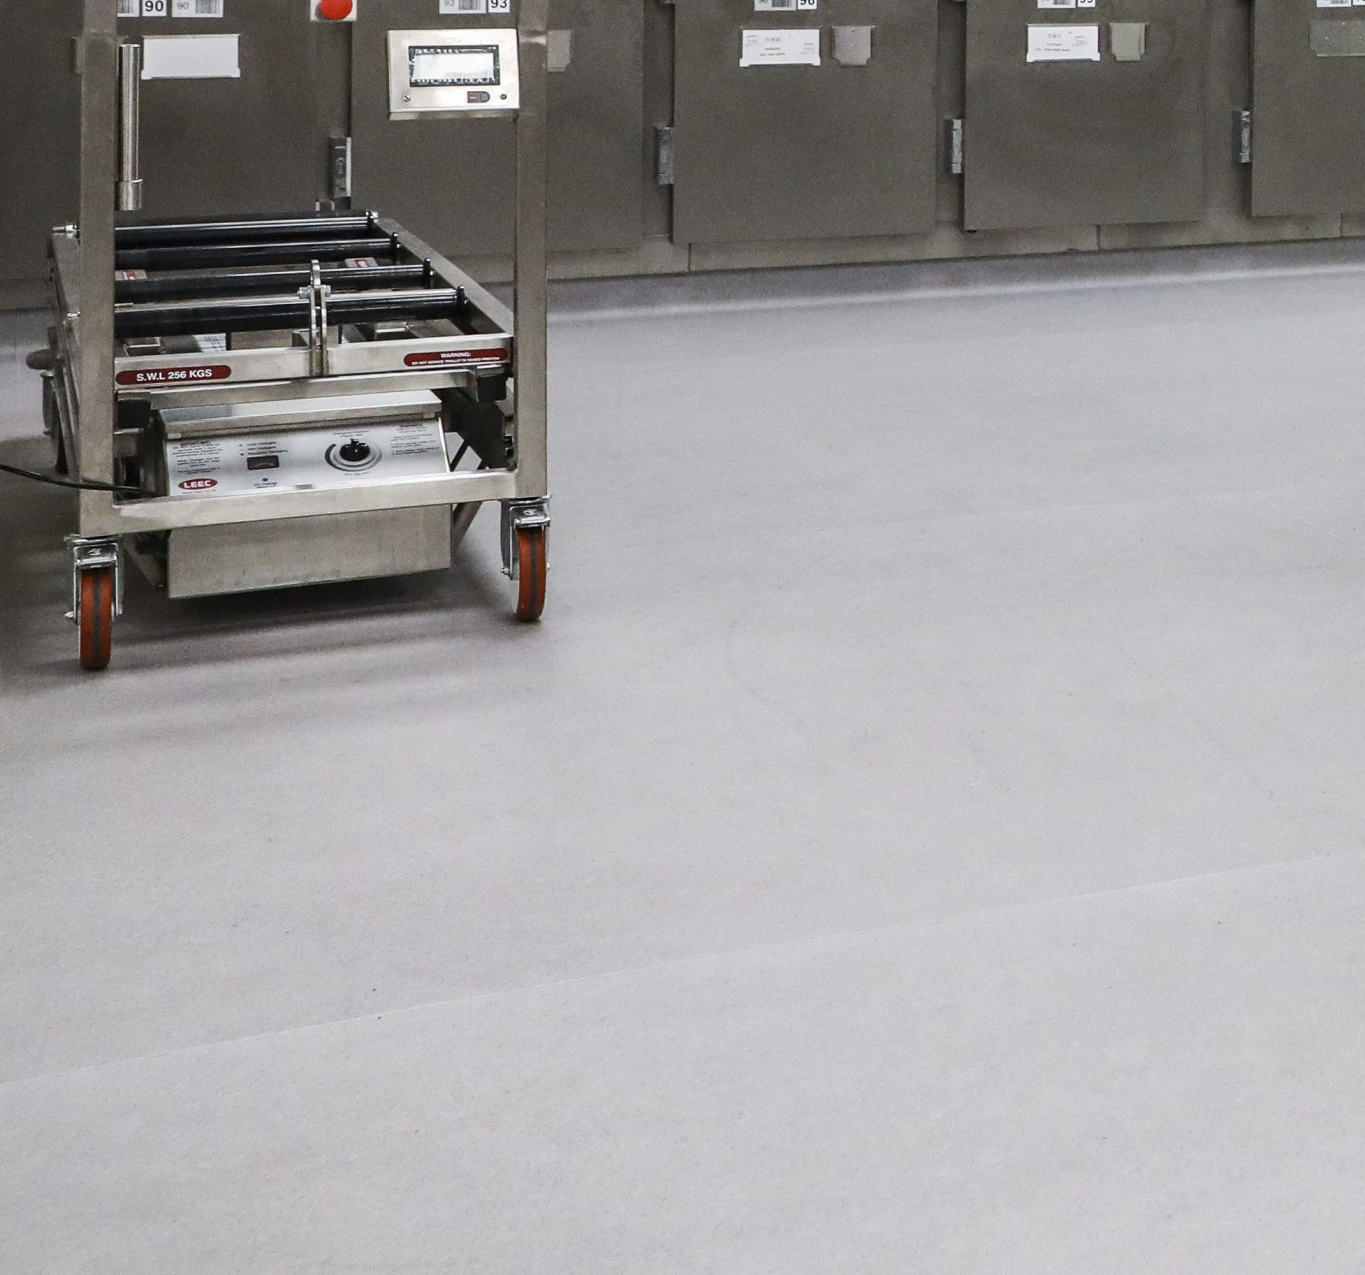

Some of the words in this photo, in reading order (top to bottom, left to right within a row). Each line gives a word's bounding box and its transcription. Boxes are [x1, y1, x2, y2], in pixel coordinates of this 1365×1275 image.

[144, 0, 164, 13] 90
[136, 371, 165, 382] S.W.L
[168, 370, 187, 380] 256
[189, 368, 213, 379] KGS
[183, 480, 213, 489] LEEC
